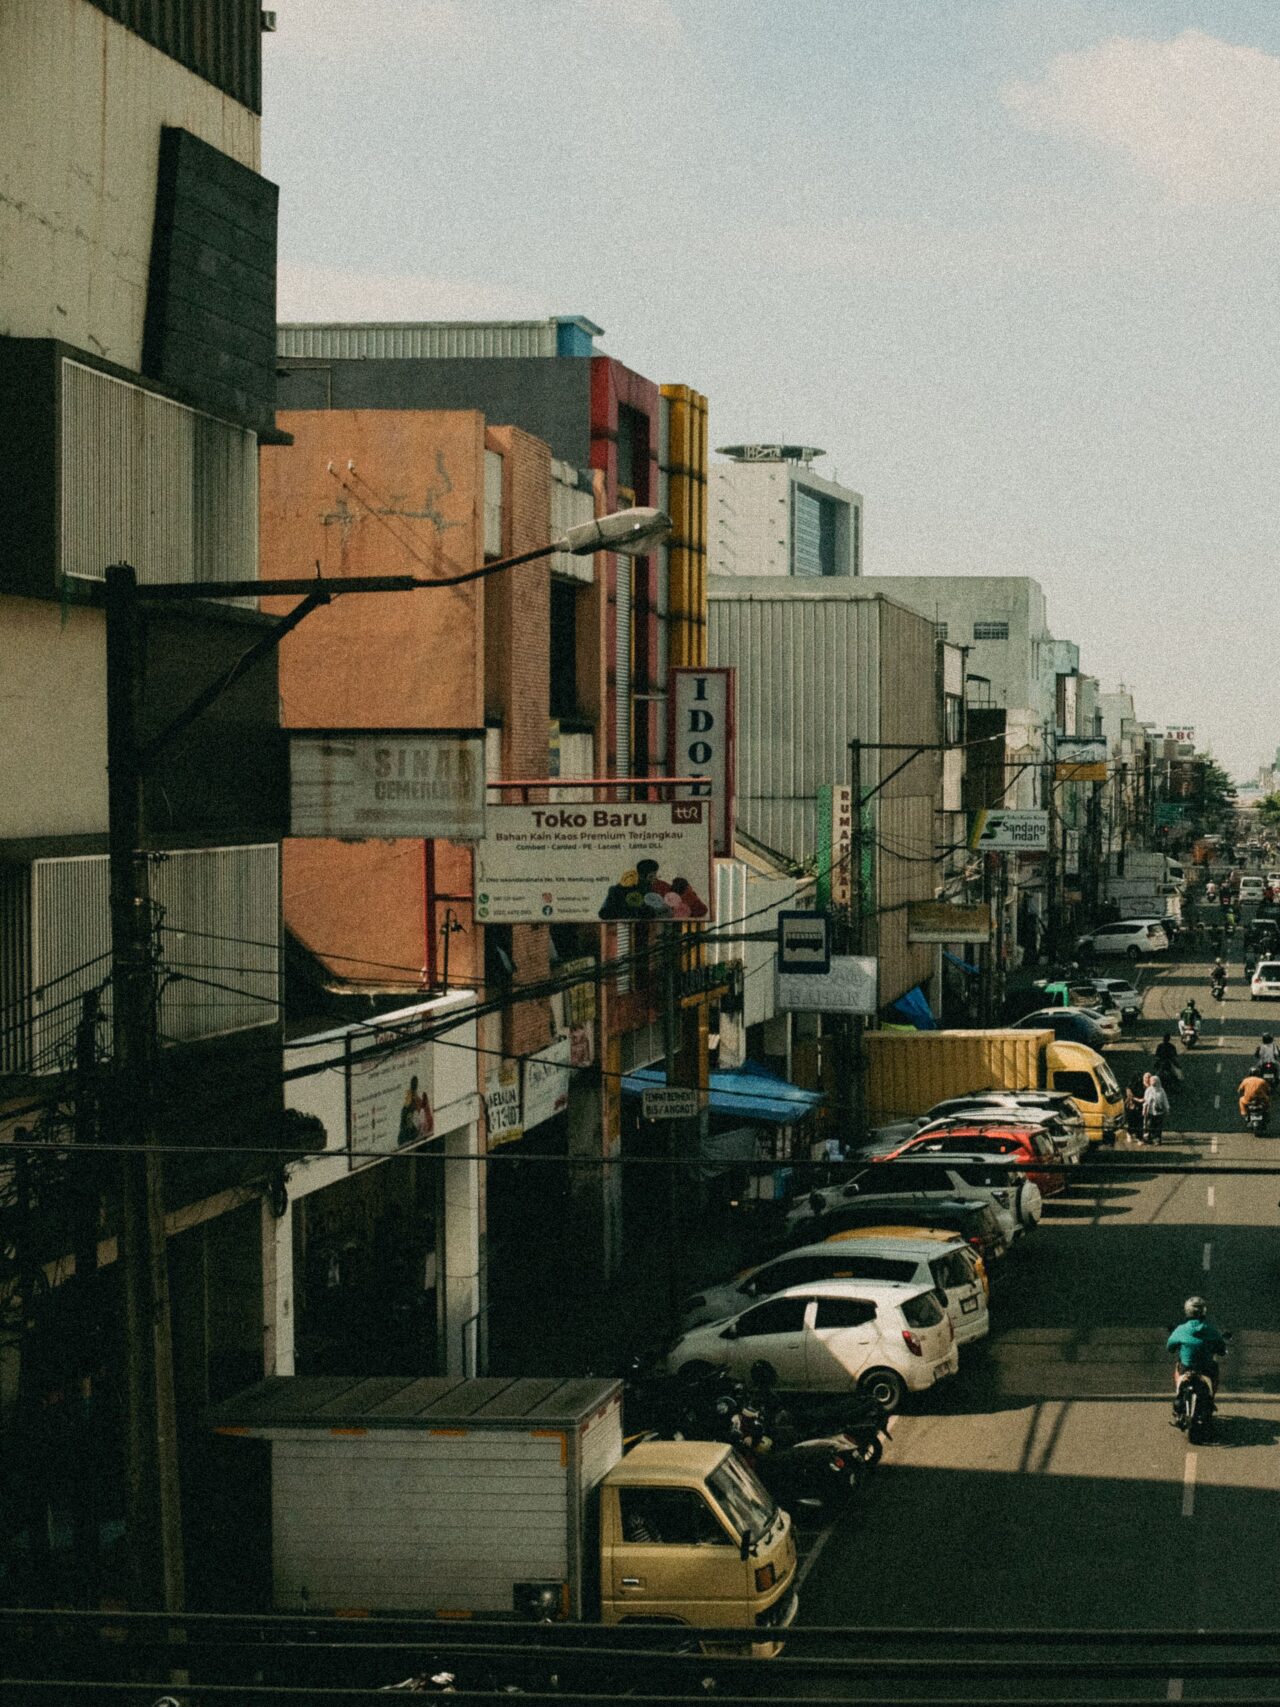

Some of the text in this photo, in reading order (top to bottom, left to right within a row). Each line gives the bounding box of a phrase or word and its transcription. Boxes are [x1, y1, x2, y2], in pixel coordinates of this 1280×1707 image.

[530, 810, 648, 828] Toko Baru
[839, 790, 850, 853] RUMAH
[1002, 821, 1046, 835] Sandang
[495, 830, 684, 843] Bahan Kain Kaos Premium Terjangkau
[1011, 830, 1040, 841] Indah
